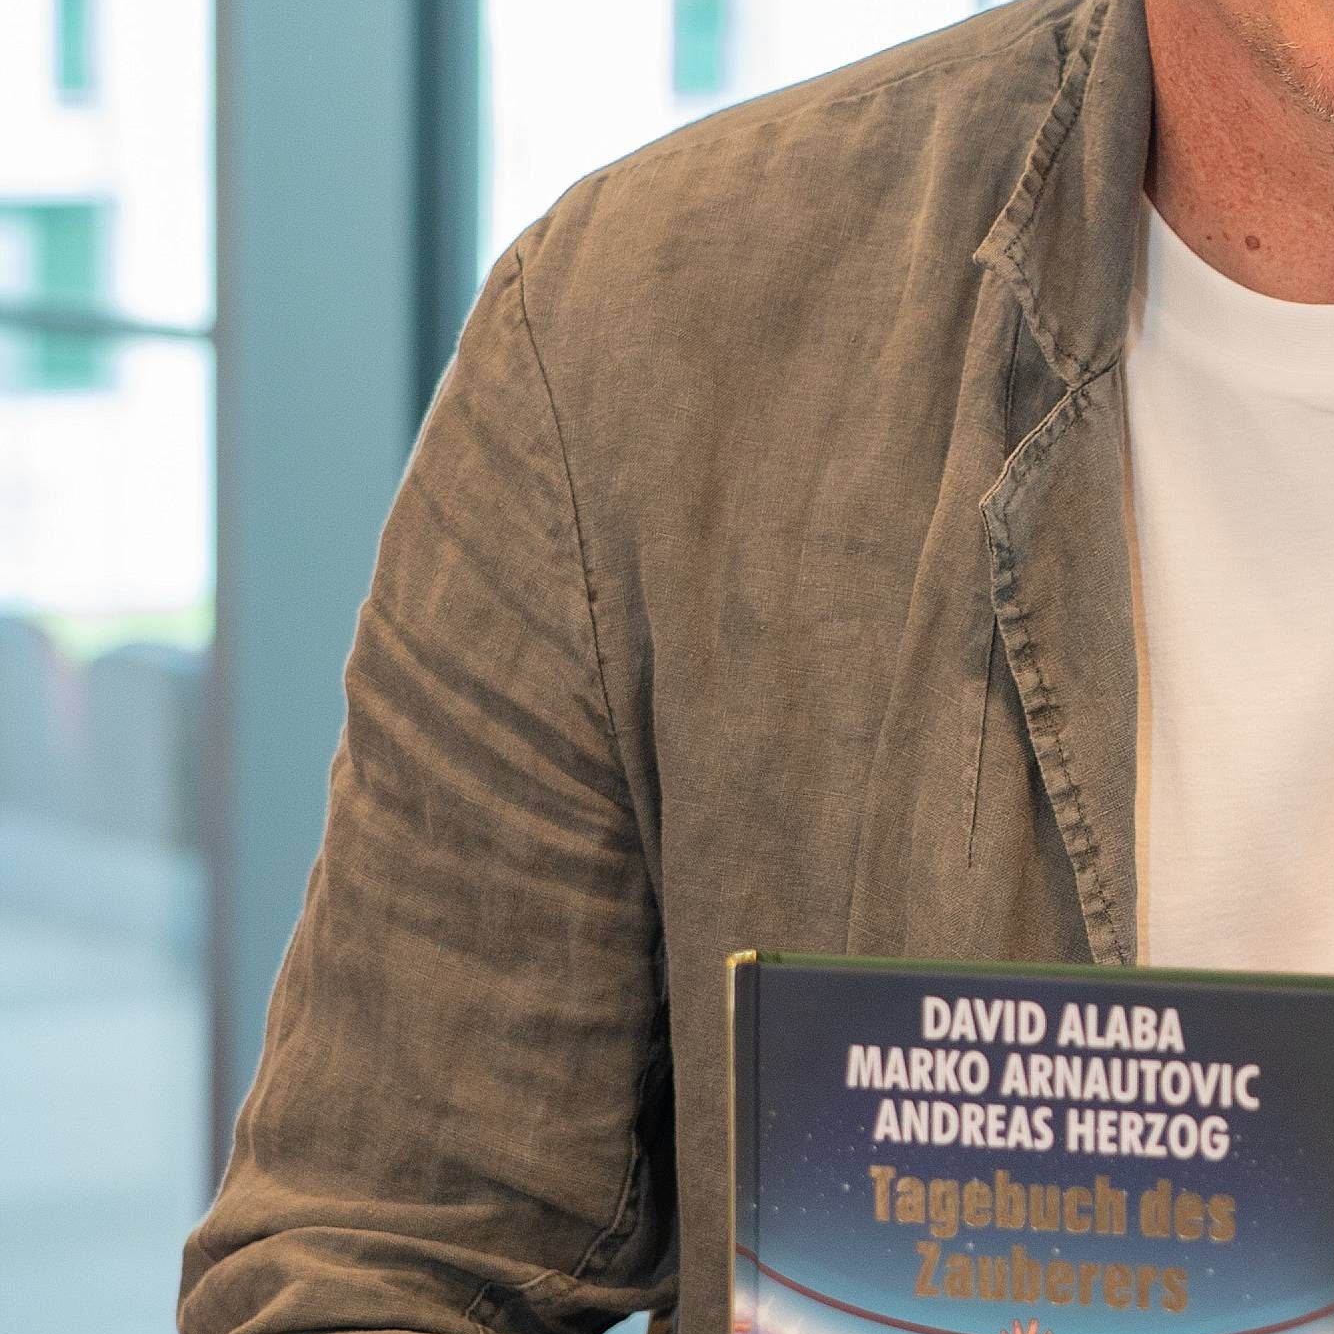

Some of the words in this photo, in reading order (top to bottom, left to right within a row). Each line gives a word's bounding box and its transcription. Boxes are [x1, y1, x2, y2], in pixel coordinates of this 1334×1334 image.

[922, 995, 1047, 1045] DAVID
[1057, 1002, 1185, 1053] ALABA
[846, 1044, 990, 1095] MARKO
[1001, 1053, 1262, 1110] ARNAUTOVIC
[873, 1098, 1054, 1151] ANDREAS
[1065, 1108, 1231, 1162] HERZOG
[868, 1164, 1128, 1239] Tagebuch
[1139, 1178, 1237, 1243] des
[914, 1240, 1190, 1313] Zauberers
